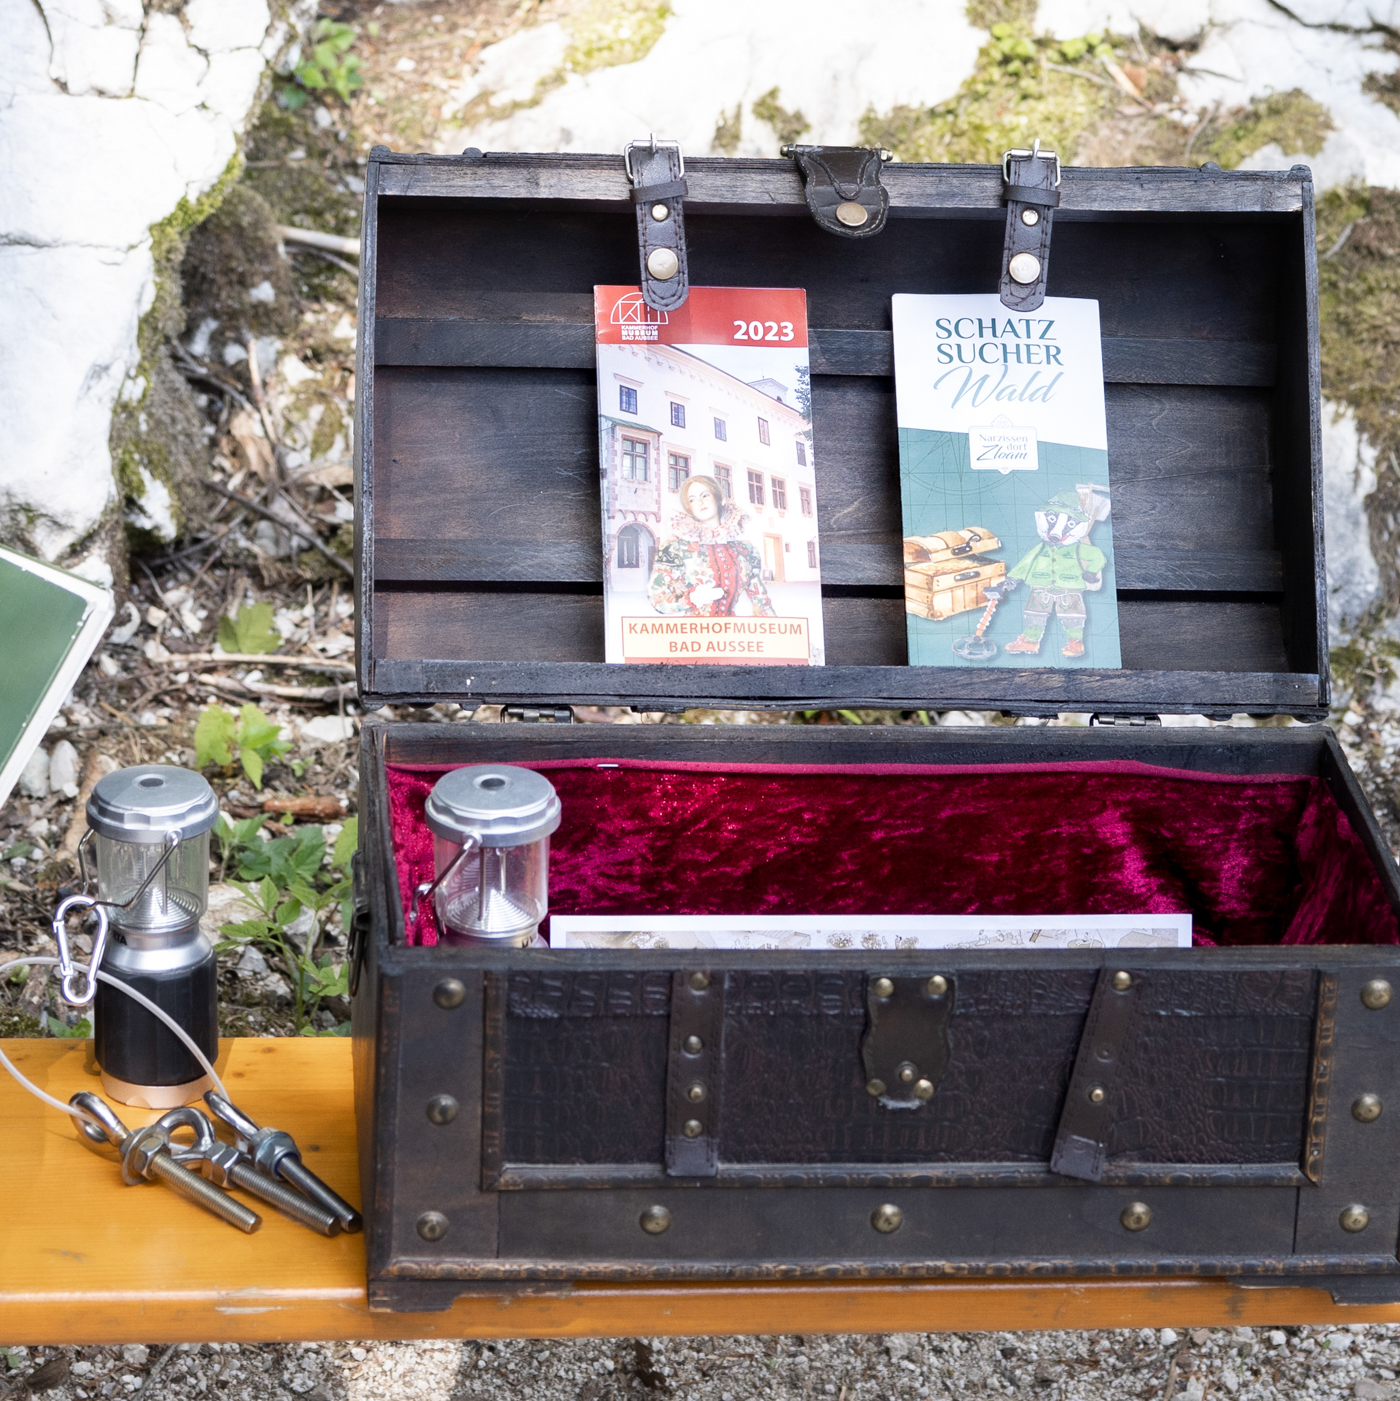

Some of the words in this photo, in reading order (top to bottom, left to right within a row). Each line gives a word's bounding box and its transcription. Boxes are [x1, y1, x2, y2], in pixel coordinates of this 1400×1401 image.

[733, 320, 795, 341] 2023
[935, 317, 1057, 340] SCHATZ
[936, 342, 1064, 366] SUCHER
[933, 364, 1064, 409] Wald
[979, 434, 1028, 442] Narzissen
[1006, 442, 1027, 451] dorf
[976, 444, 1028, 461] Zloam
[628, 622, 802, 635] KAMMERHOFMUSEUM
[669, 641, 701, 653] BAD
[706, 641, 764, 653] AUSSEE
